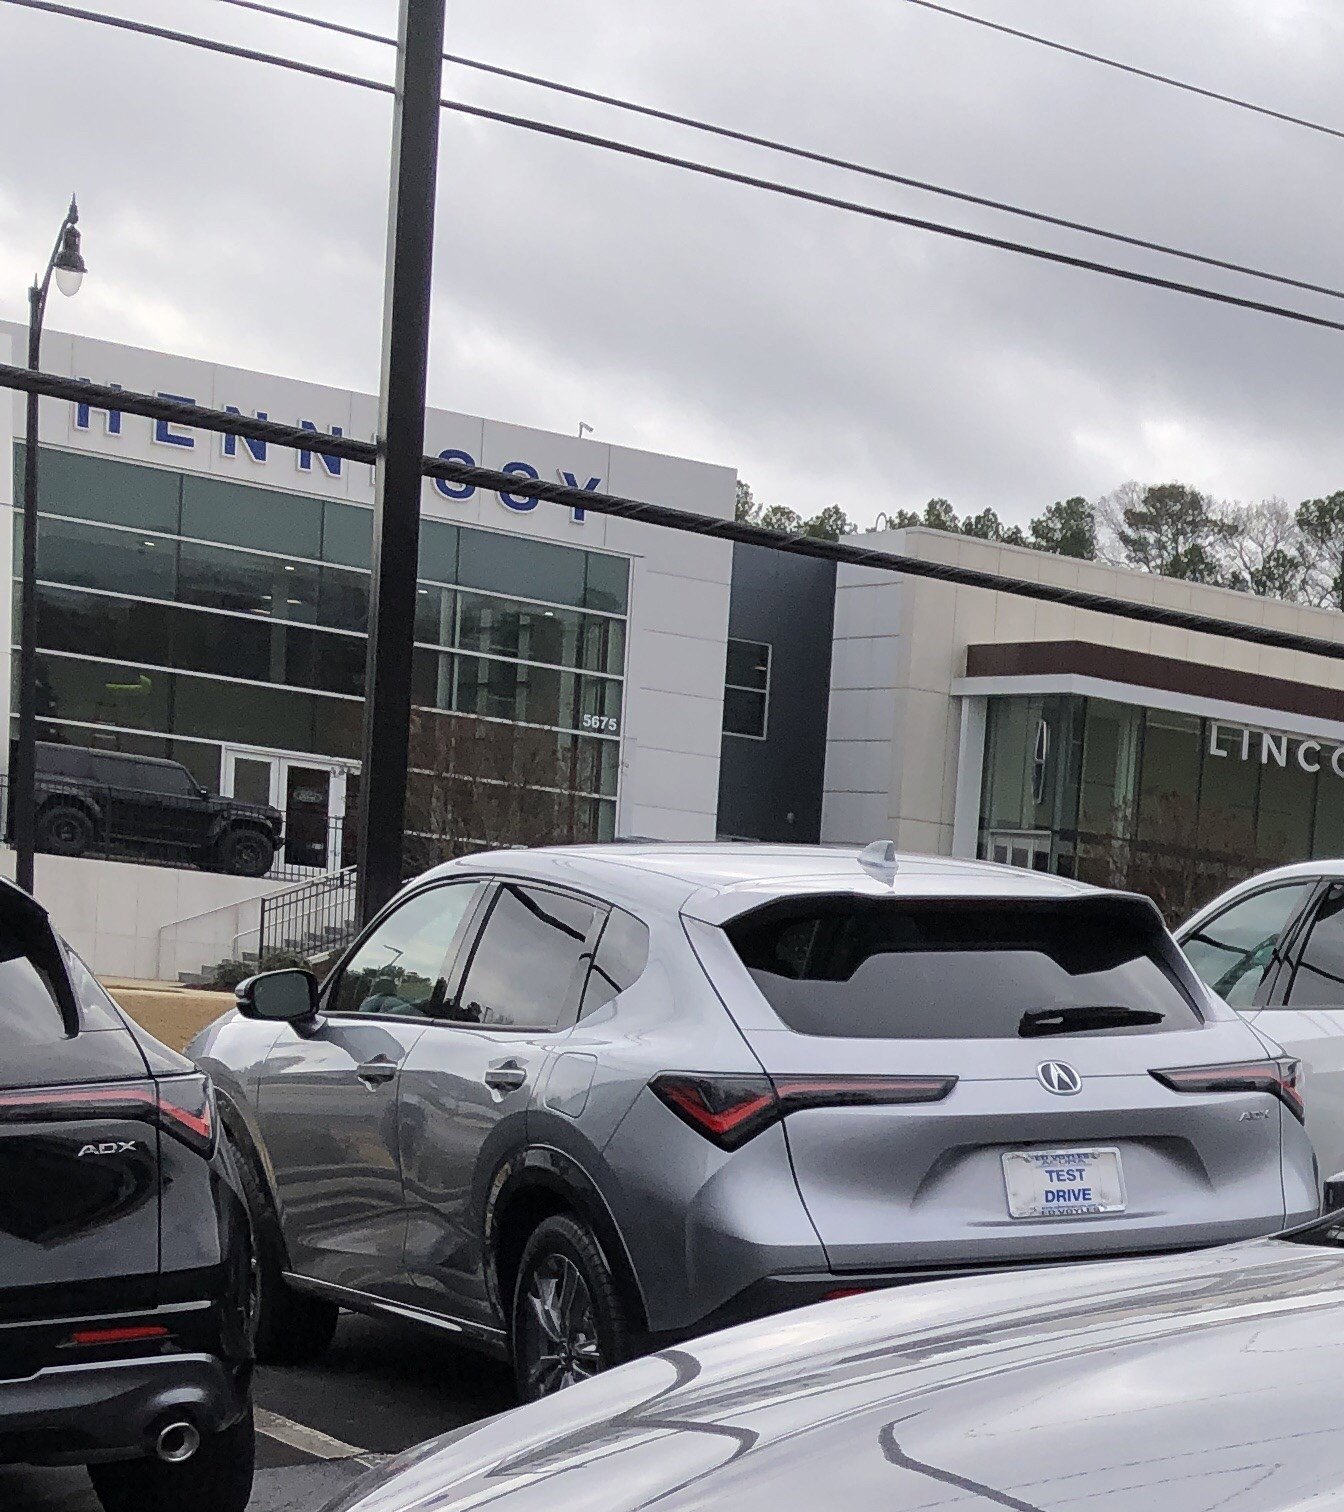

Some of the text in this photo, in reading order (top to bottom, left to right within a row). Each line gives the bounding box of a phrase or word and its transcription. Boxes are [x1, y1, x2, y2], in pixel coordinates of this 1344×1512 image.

[73, 376, 602, 525] HENNSSY
[582, 713, 617, 731] 5675
[77, 1140, 137, 1157] ADX
[1045, 1168, 1086, 1183] TEST
[1044, 1187, 1092, 1203] DRIVE
